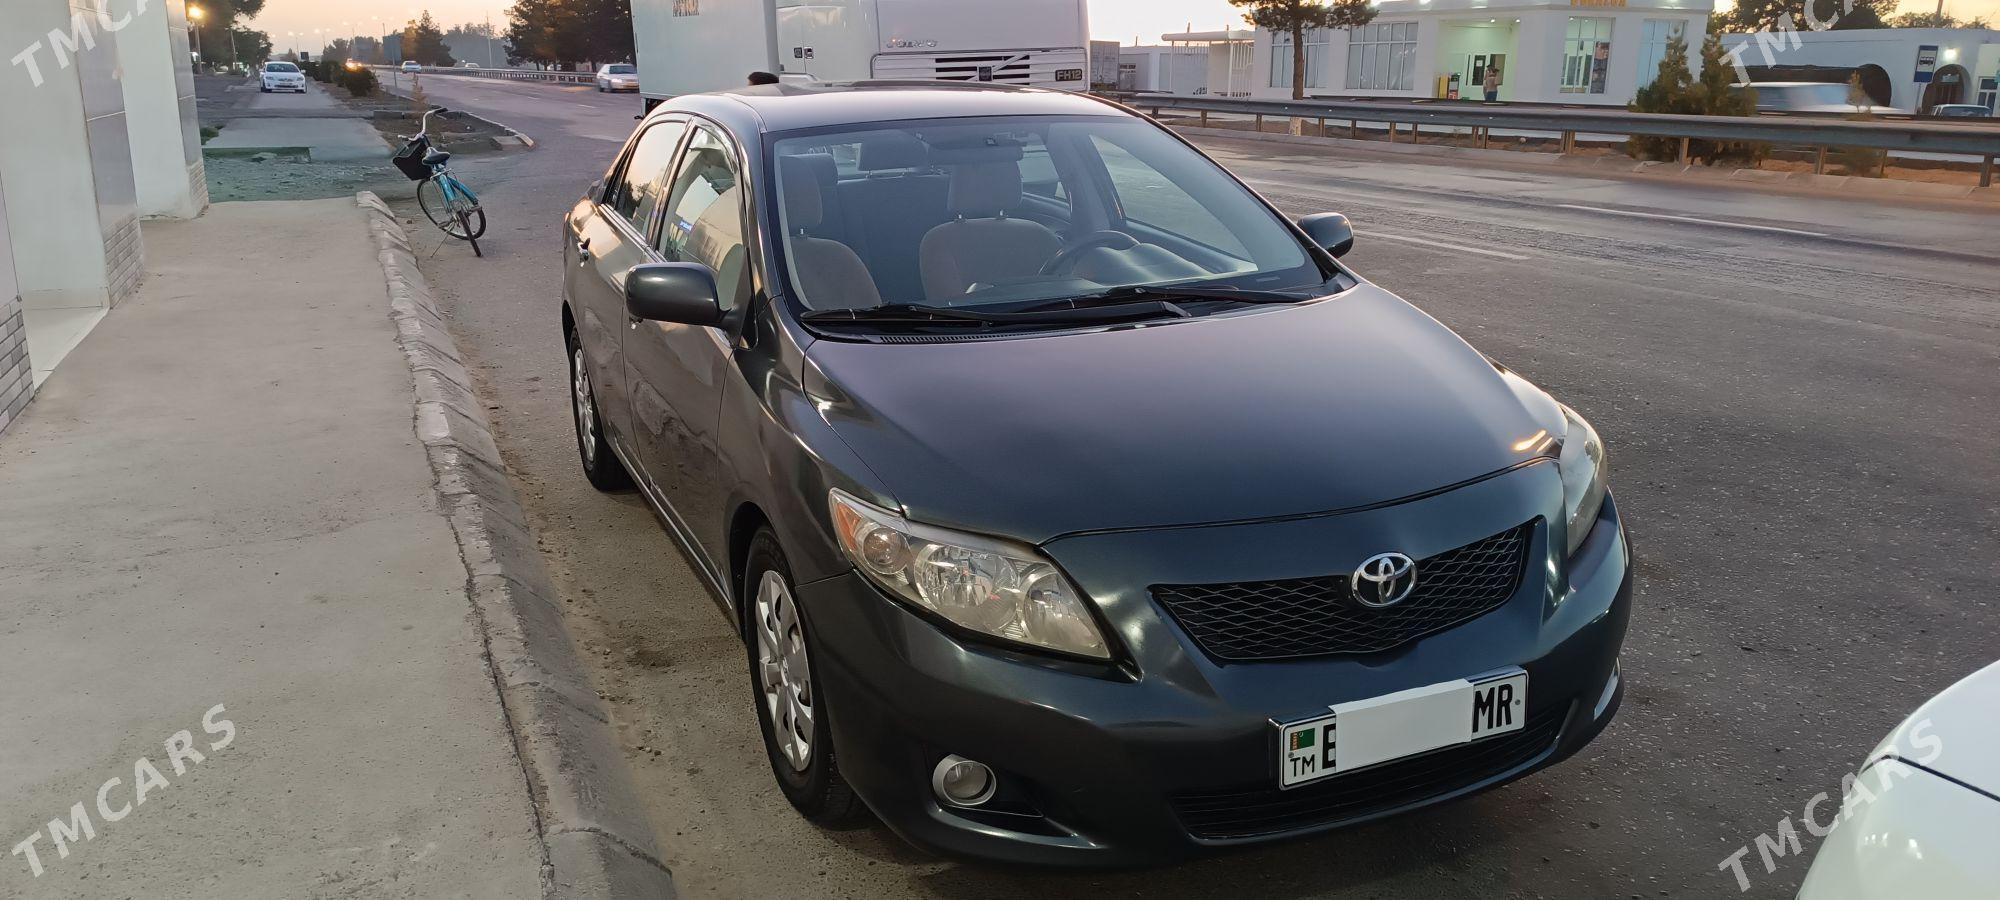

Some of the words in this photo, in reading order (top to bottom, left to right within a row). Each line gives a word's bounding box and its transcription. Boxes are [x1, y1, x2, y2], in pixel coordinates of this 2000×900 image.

[1056, 70, 1082, 80] FH12
[1472, 683, 1513, 733] MR
[1290, 754, 1315, 777] TM
